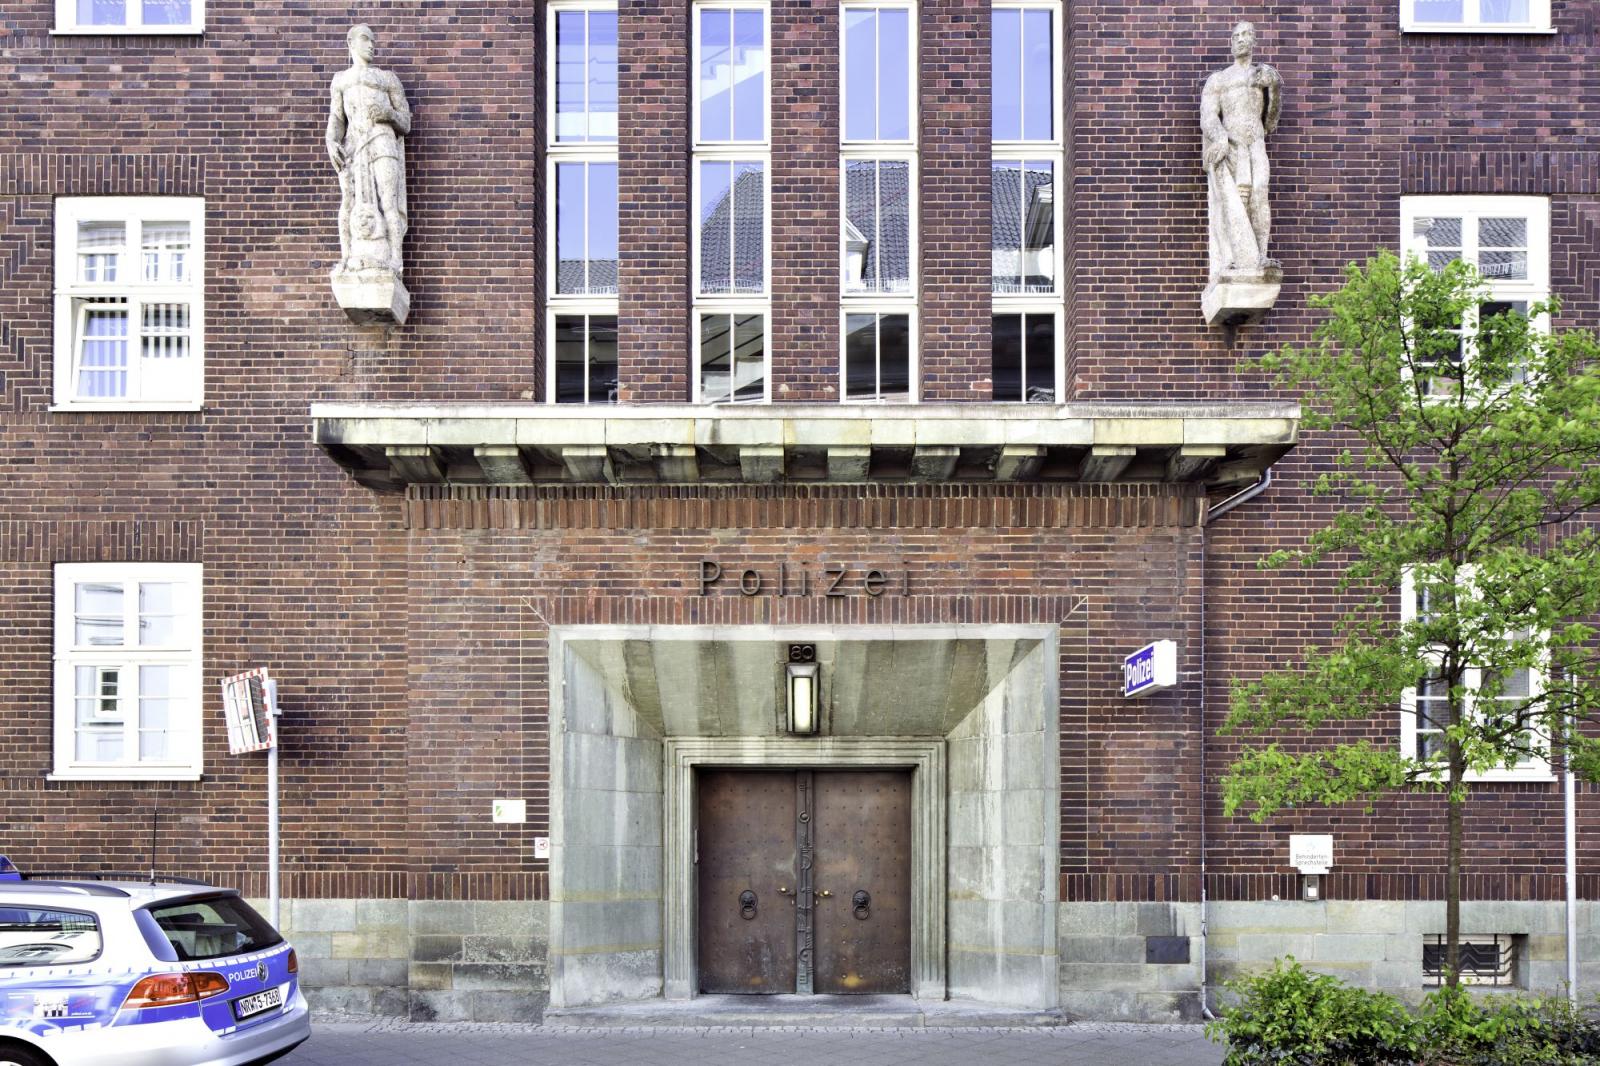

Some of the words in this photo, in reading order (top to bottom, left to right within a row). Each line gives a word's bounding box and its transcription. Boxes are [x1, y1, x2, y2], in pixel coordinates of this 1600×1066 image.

[699, 560, 910, 597] Polizei
[1126, 651, 1154, 689] Polizei
[228, 968, 257, 983] POLIZEI
